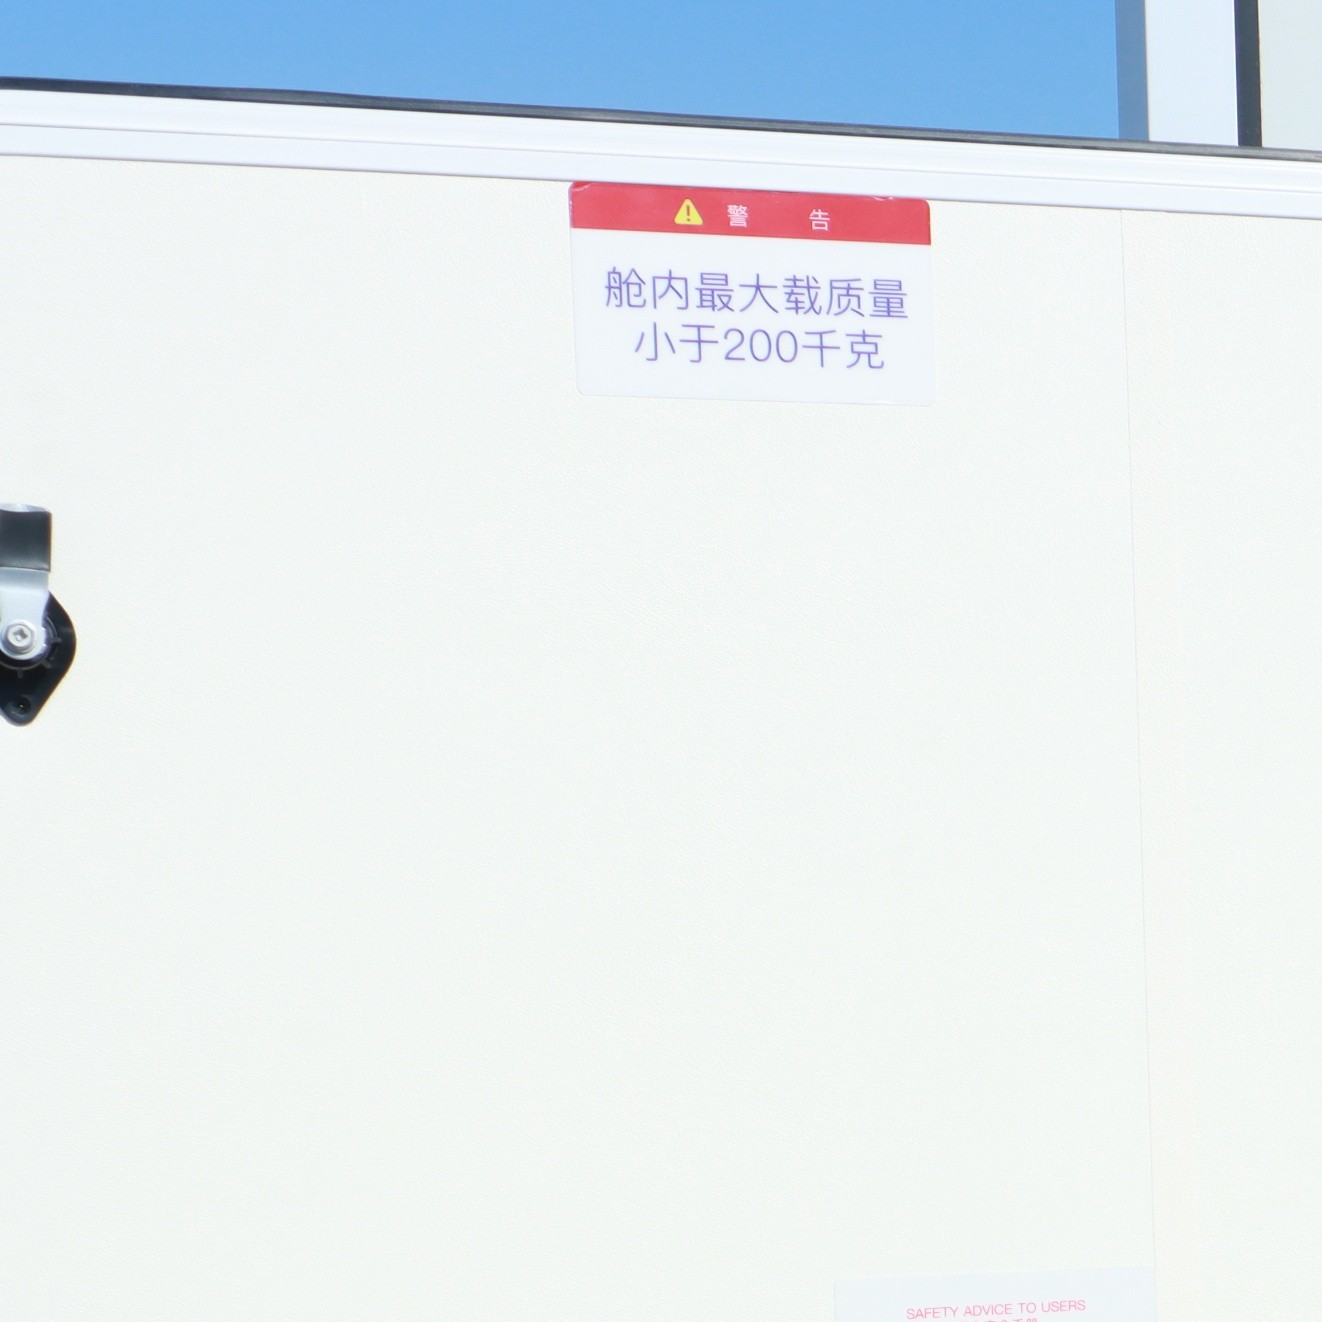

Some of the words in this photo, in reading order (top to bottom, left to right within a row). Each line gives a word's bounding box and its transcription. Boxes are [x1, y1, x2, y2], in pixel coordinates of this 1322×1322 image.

[604, 266, 909, 320] 舱内最大载质量
[634, 322, 885, 370] 小于200千克
[906, 1306, 958, 1320] SAFETY
[963, 1303, 1013, 1318] ADVICE
[1018, 1302, 1037, 1315] TO
[1041, 1299, 1086, 1313] USERS
